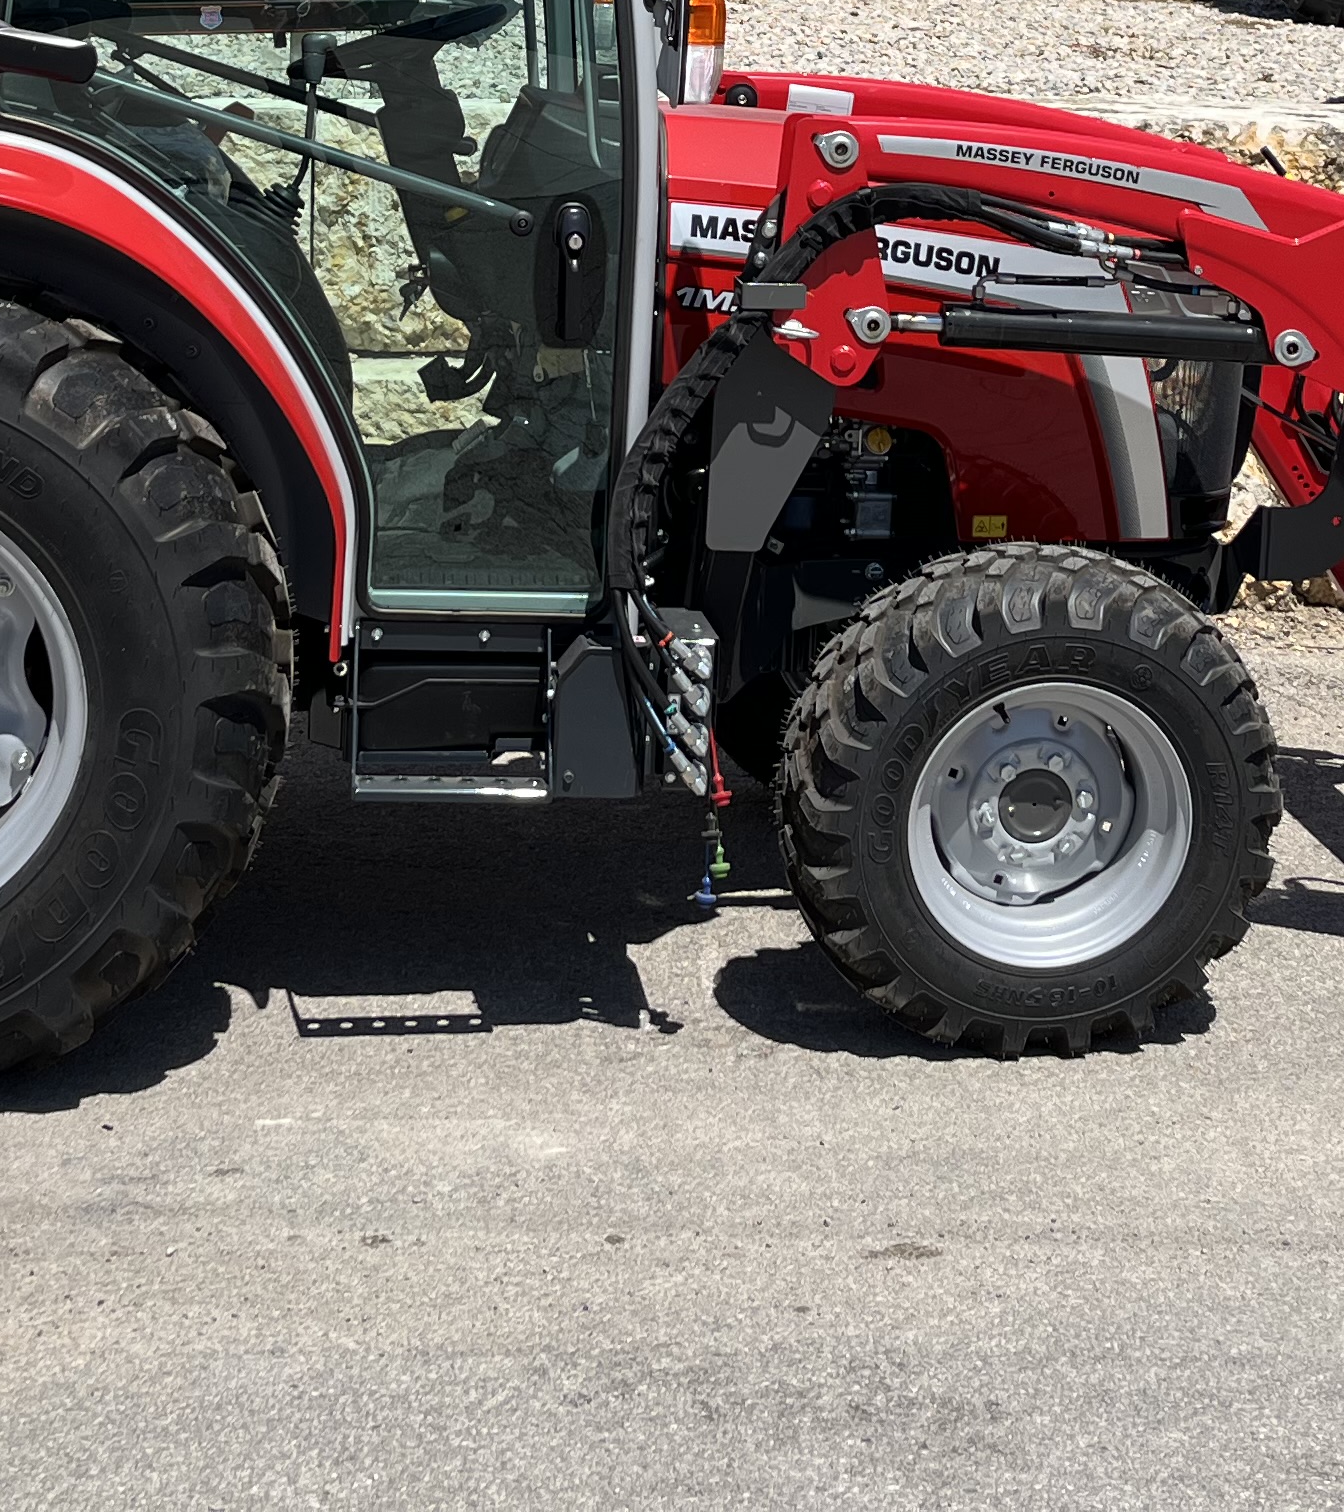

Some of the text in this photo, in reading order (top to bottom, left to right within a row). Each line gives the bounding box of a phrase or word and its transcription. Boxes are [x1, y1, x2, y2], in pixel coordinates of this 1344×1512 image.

[955, 143, 1141, 185] MASSEY FERGUSON
[689, 213, 1001, 278] MAS RGUSON
[867, 642, 1098, 864] GOODYEAR
